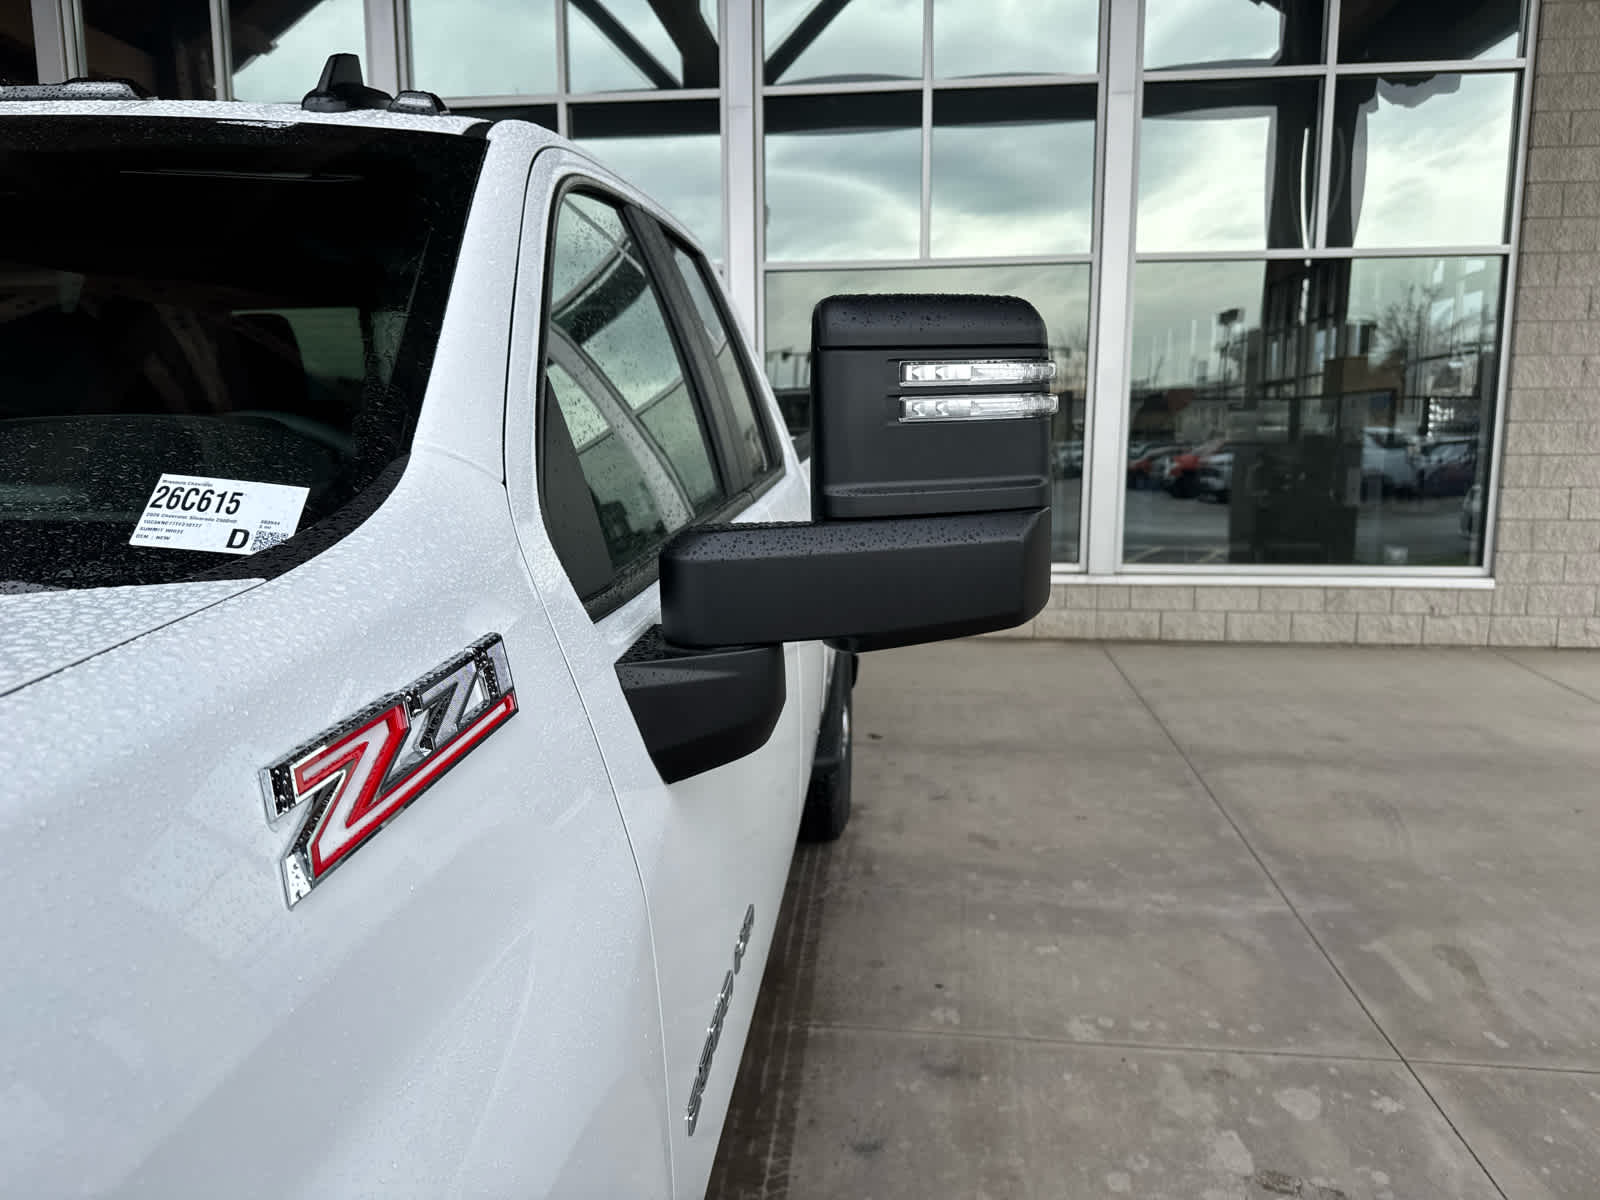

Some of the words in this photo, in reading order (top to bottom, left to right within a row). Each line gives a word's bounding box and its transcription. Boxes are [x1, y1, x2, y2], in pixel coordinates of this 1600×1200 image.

[149, 485, 243, 515] 26C615
[225, 528, 250, 549] D
[258, 632, 519, 910] Z71
